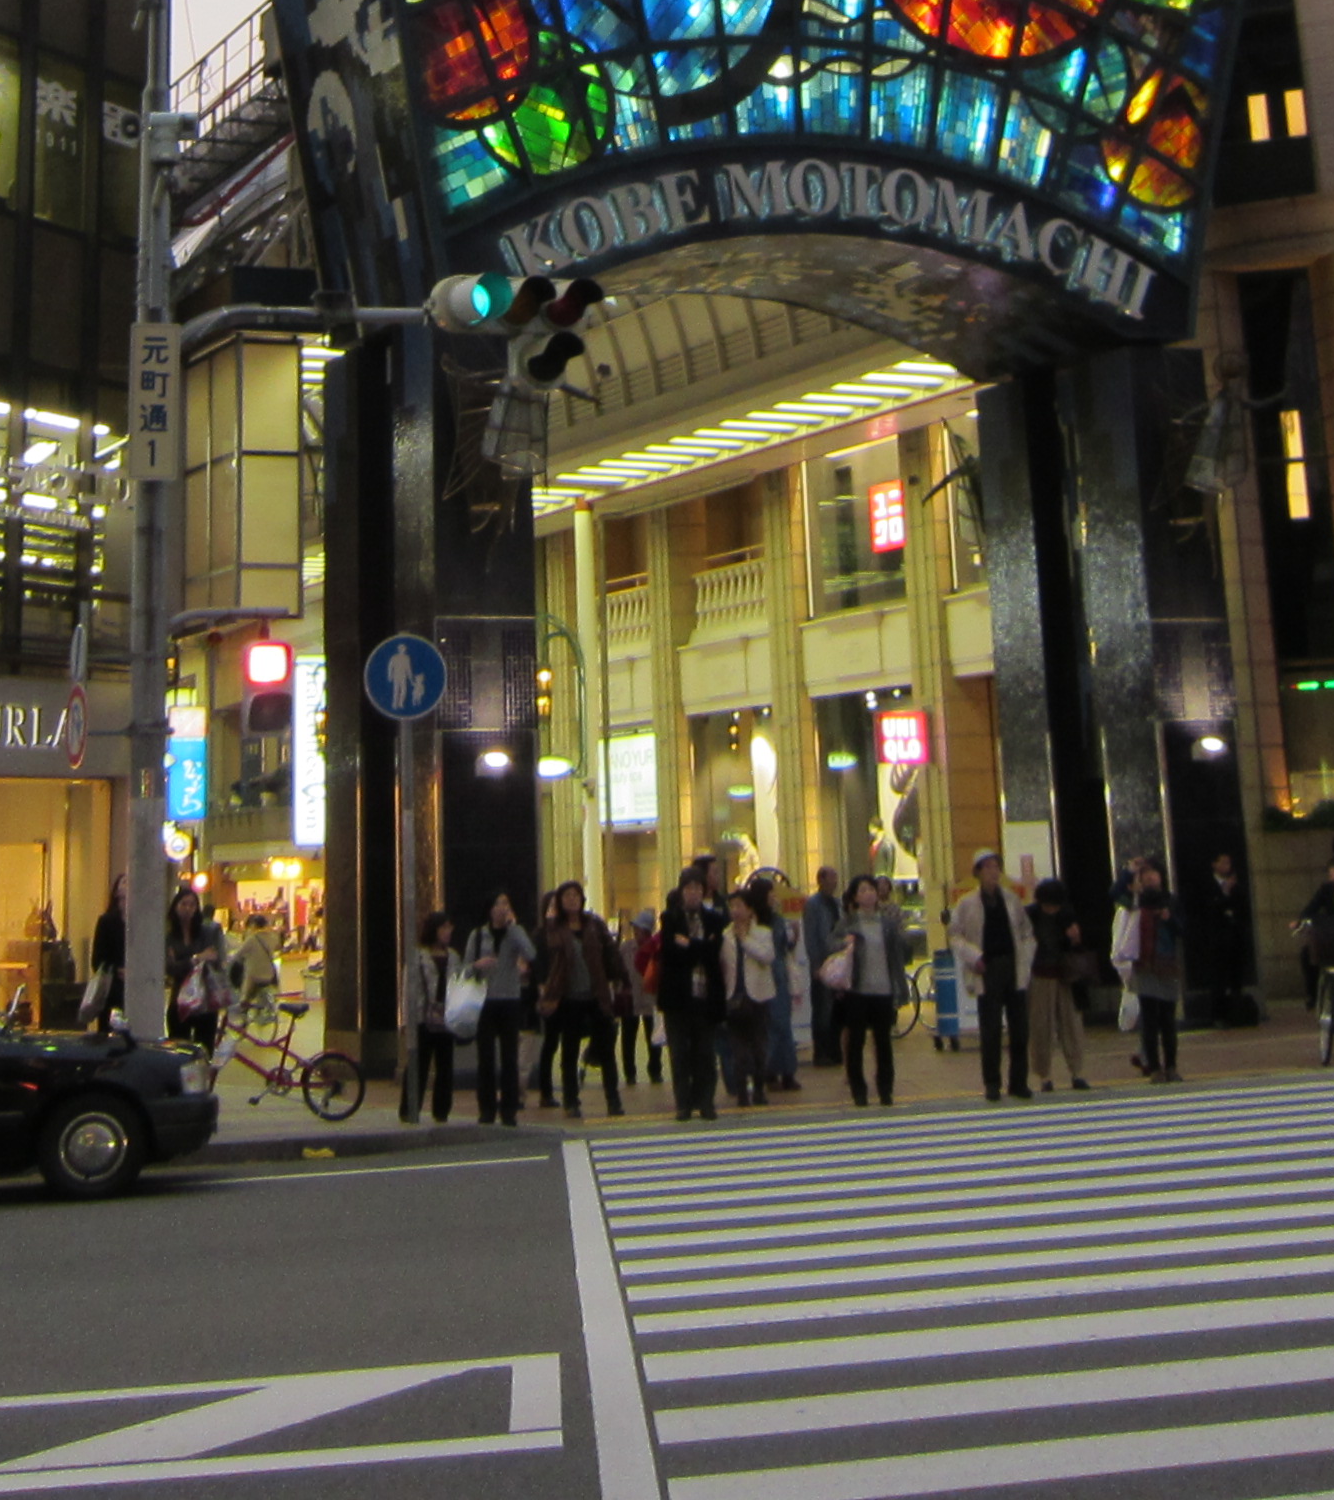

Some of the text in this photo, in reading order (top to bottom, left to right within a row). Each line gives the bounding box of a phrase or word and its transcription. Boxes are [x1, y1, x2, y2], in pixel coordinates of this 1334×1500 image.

[502, 157, 1158, 322] KOBE MOTOMACHI
[139, 336, 170, 468] 元町通1
[882, 717, 917, 738] UNI
[883, 738, 922, 762] QLO
